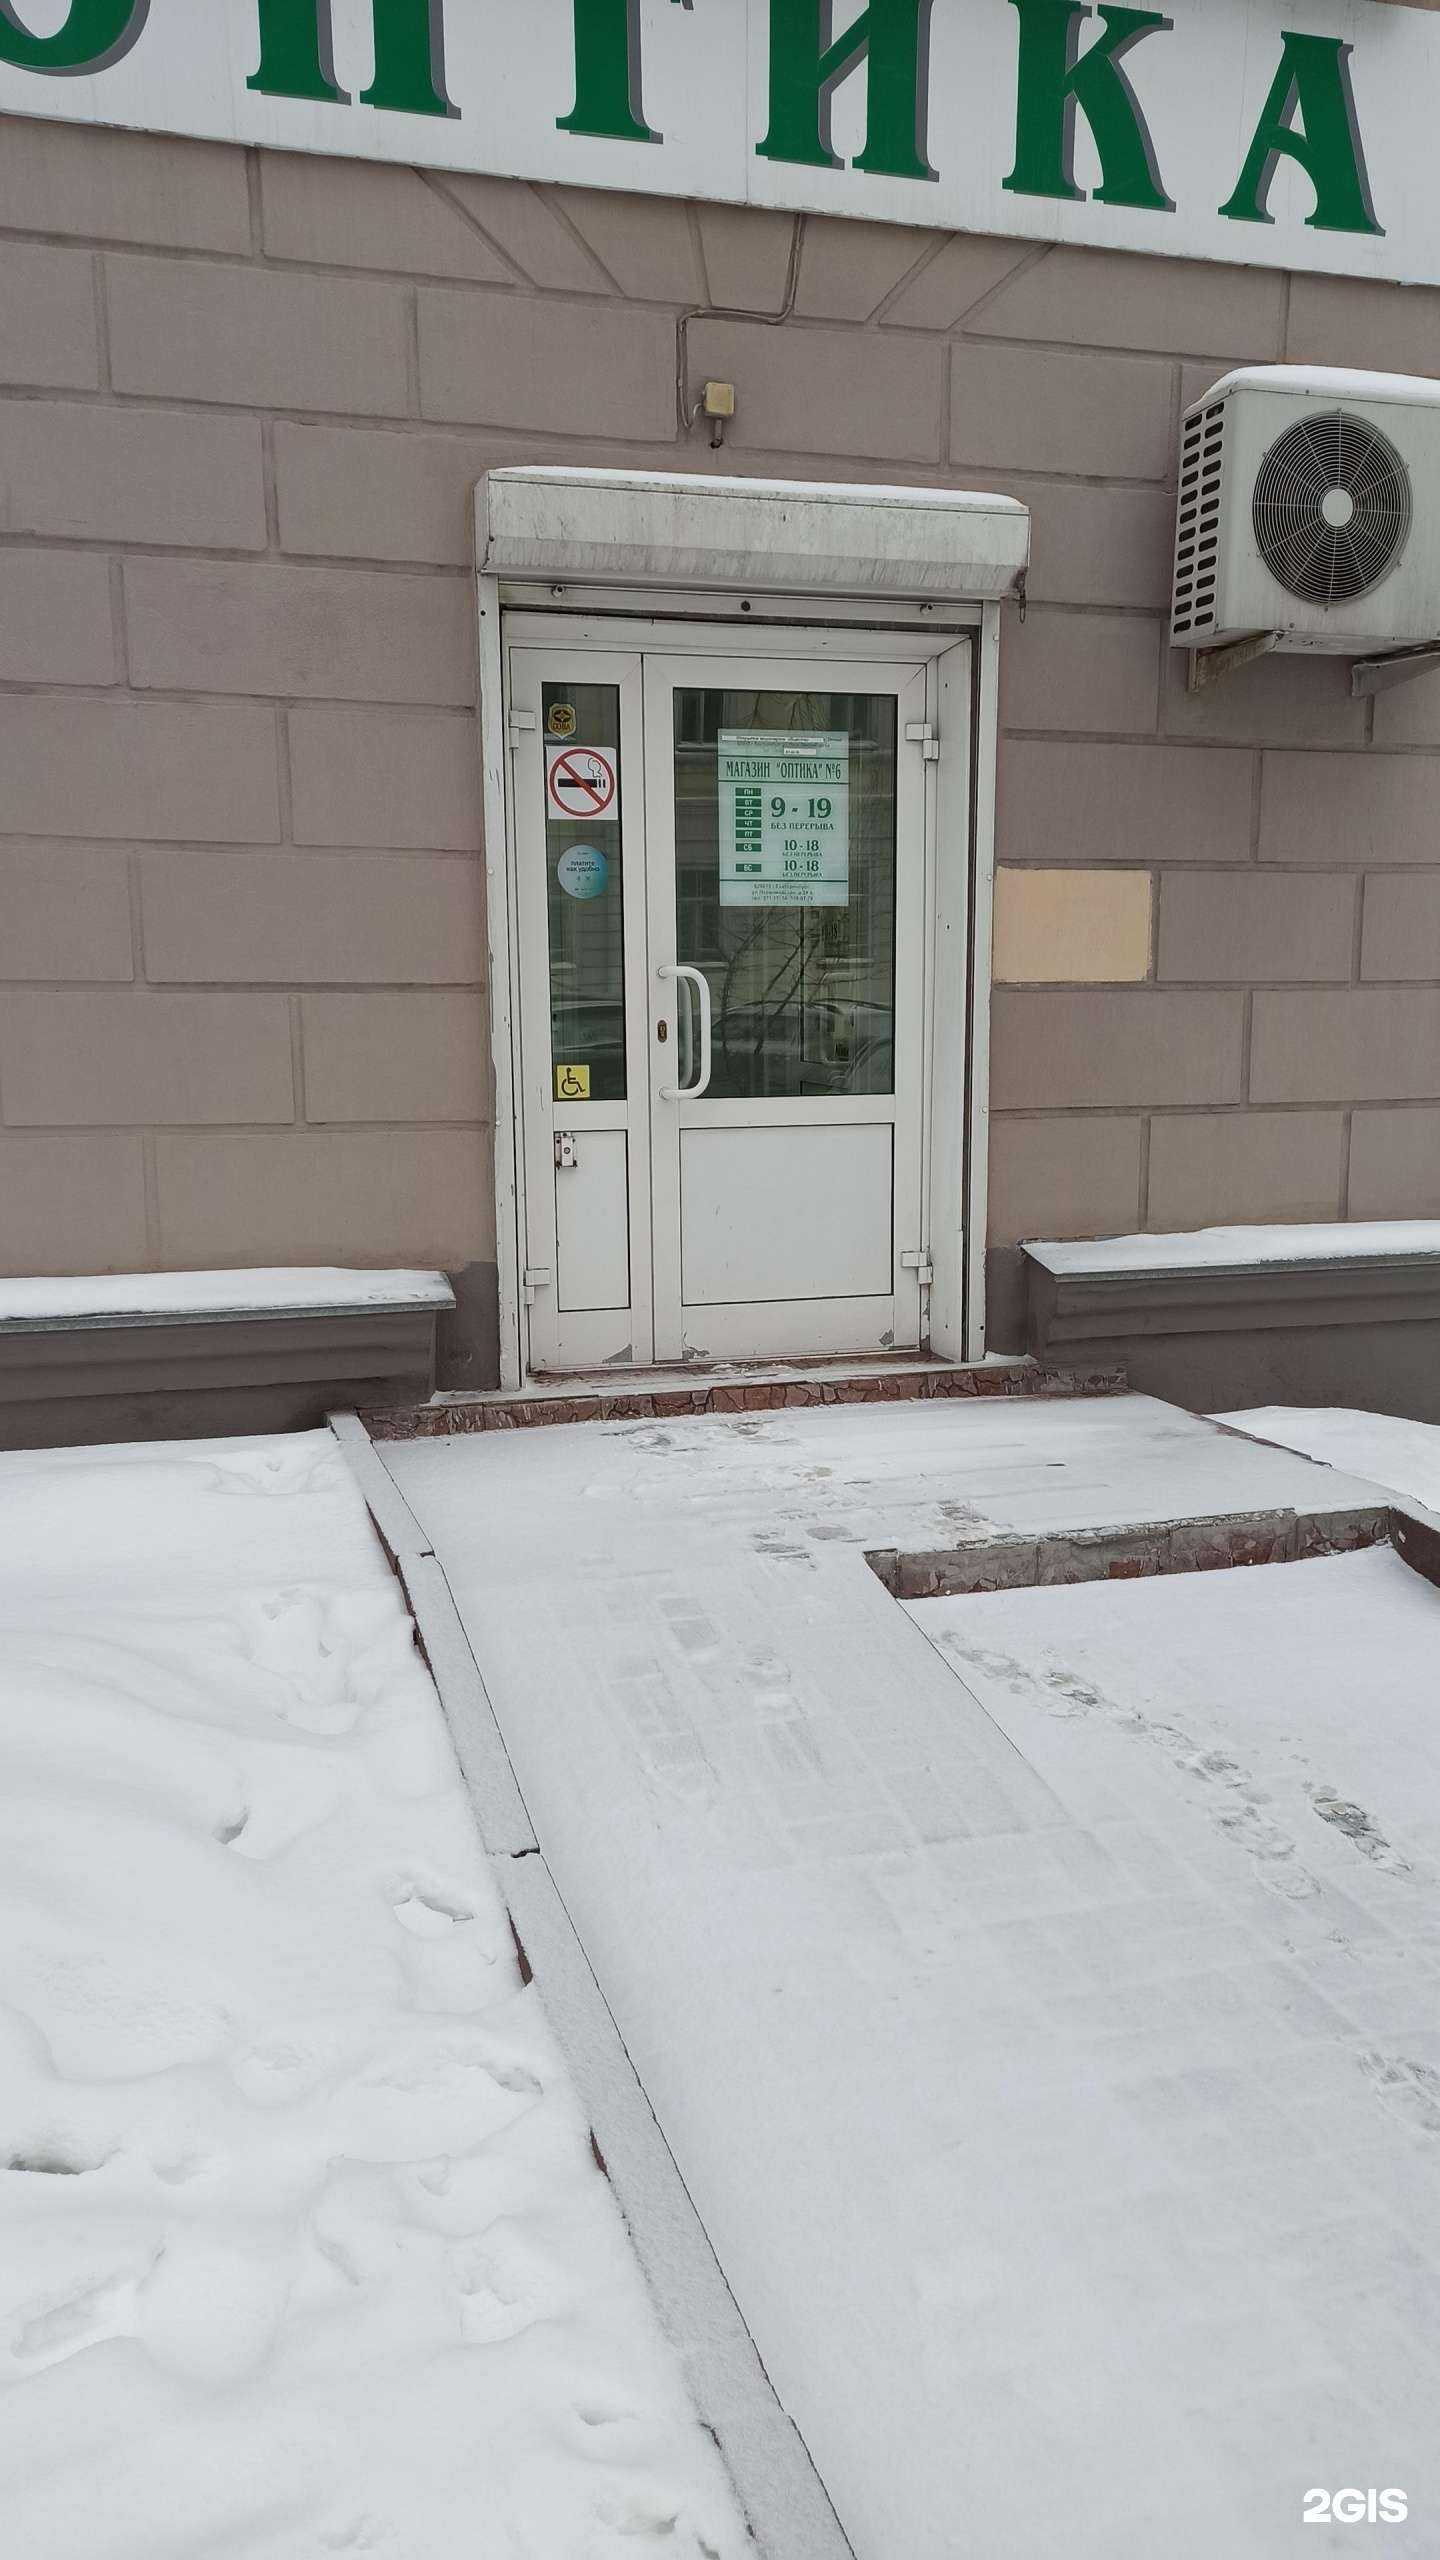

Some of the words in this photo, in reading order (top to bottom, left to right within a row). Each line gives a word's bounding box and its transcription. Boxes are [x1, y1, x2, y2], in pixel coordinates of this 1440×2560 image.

[726, 761, 770, 778] МАГАЗИН
[776, 762, 823, 779] "ОПТИКА"
[771, 796, 786, 818] 9
[808, 797, 832, 819] 19
[770, 822, 786, 830] БЕЗ
[789, 822, 834, 831] ПЕРЕРЫВА
